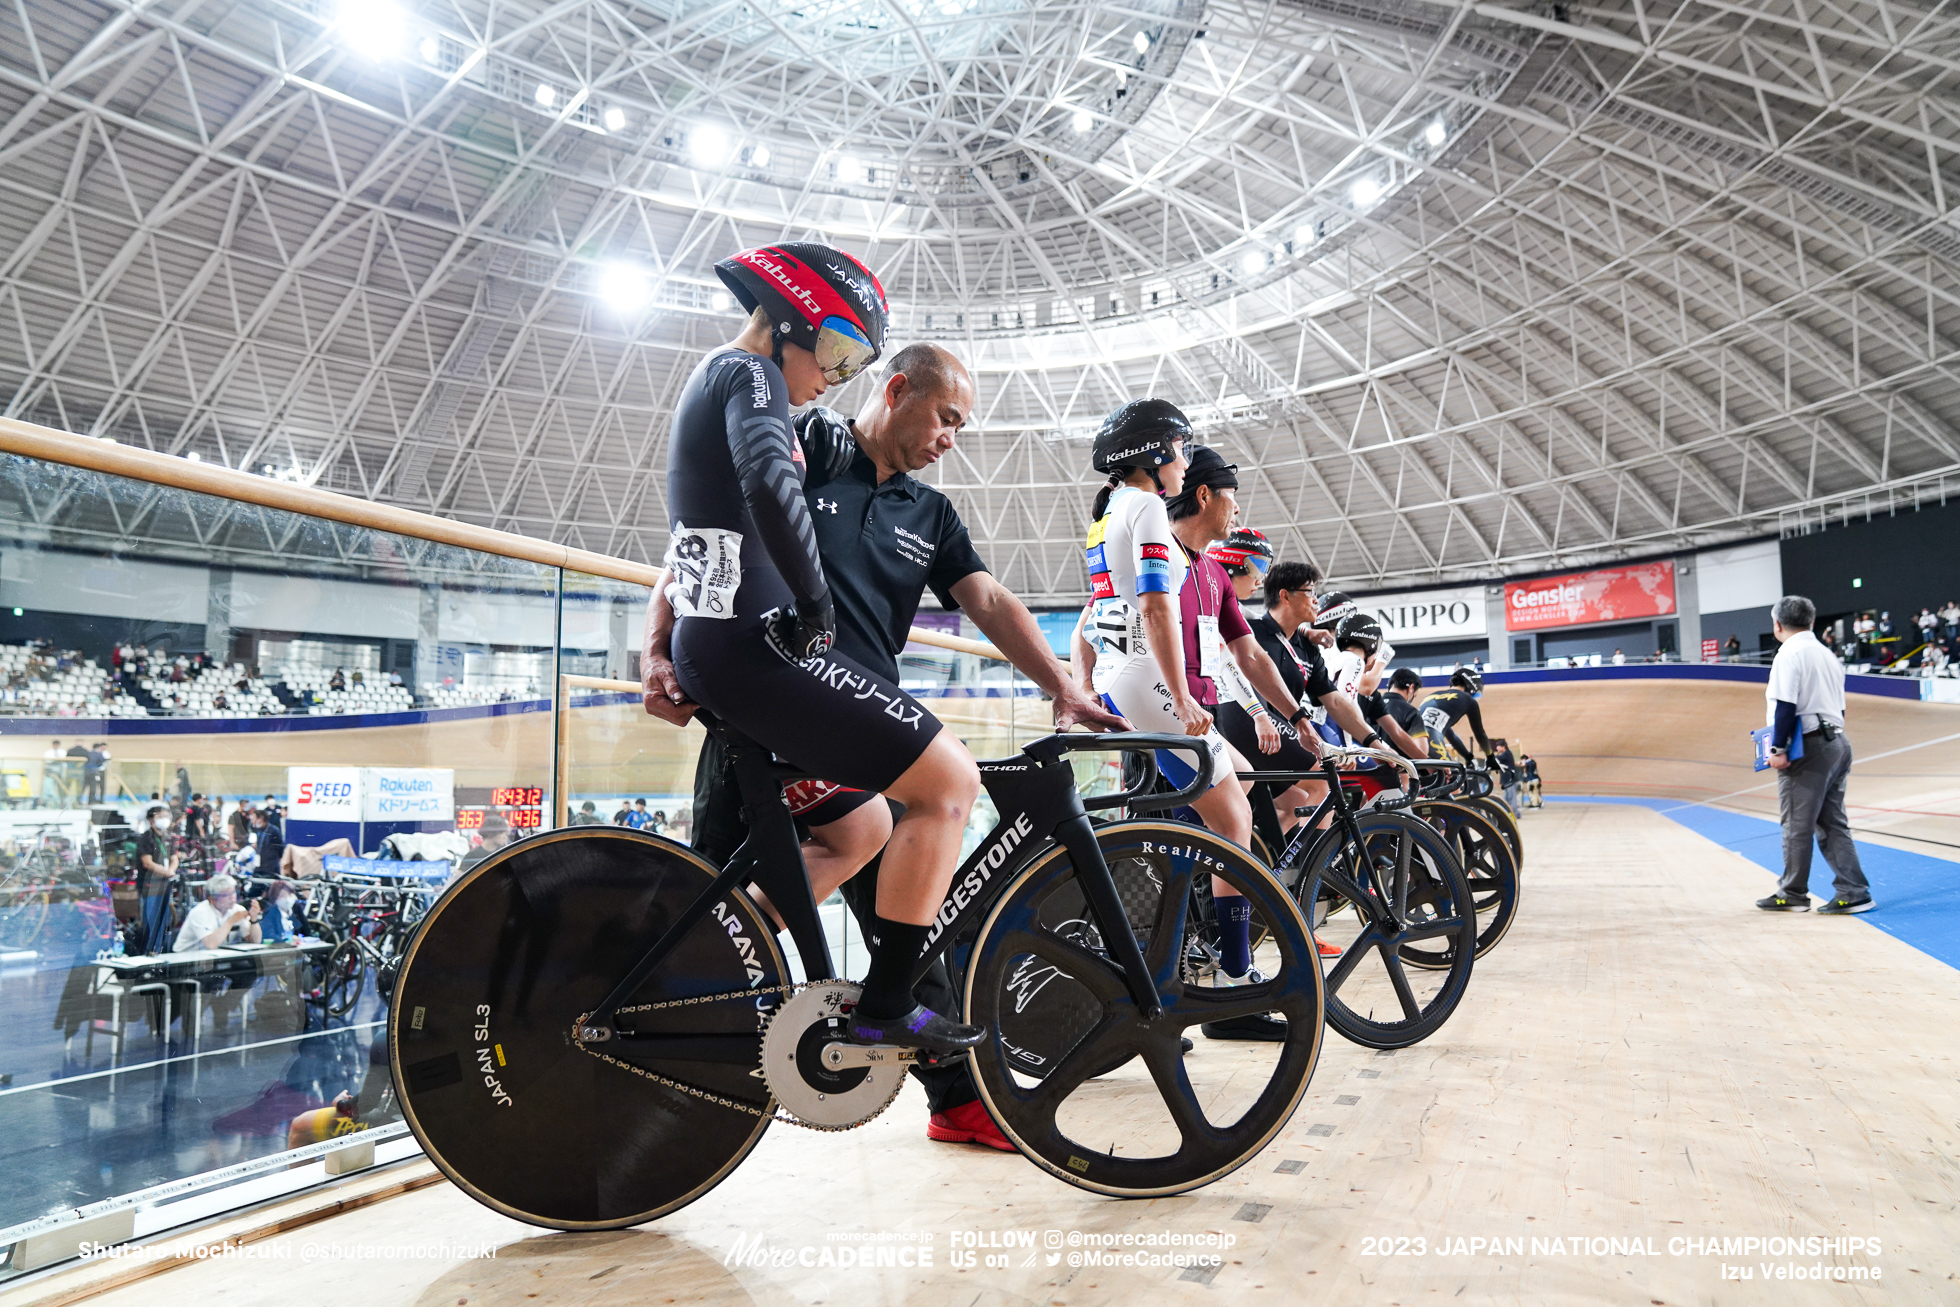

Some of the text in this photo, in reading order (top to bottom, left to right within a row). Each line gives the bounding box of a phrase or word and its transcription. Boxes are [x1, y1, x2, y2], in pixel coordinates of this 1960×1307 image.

[742, 251, 822, 314] Kabuto
[826, 263, 874, 311] JAPAN
[1106, 440, 1160, 463] Kabuto
[1512, 584, 1584, 609] Gensler
[1512, 602, 1586, 616] DESIGN WORLDWIDE
[1378, 601, 1471, 629] NIPPO
[1512, 608, 1586, 623] WWW.GENSLER.COM
[821, 662, 924, 731] Kドリームス
[297, 782, 352, 804] SPEED
[380, 777, 433, 793] Rakuten
[491, 788, 542, 806] 16:43:12
[379, 798, 440, 812] Kドリームス
[457, 810, 485, 829] 363
[1142, 841, 1226, 872] Realize
[711, 901, 765, 989] ARAYA
[474, 1004, 491, 1041] SL3
[476, 1048, 513, 1107] JAPAN
